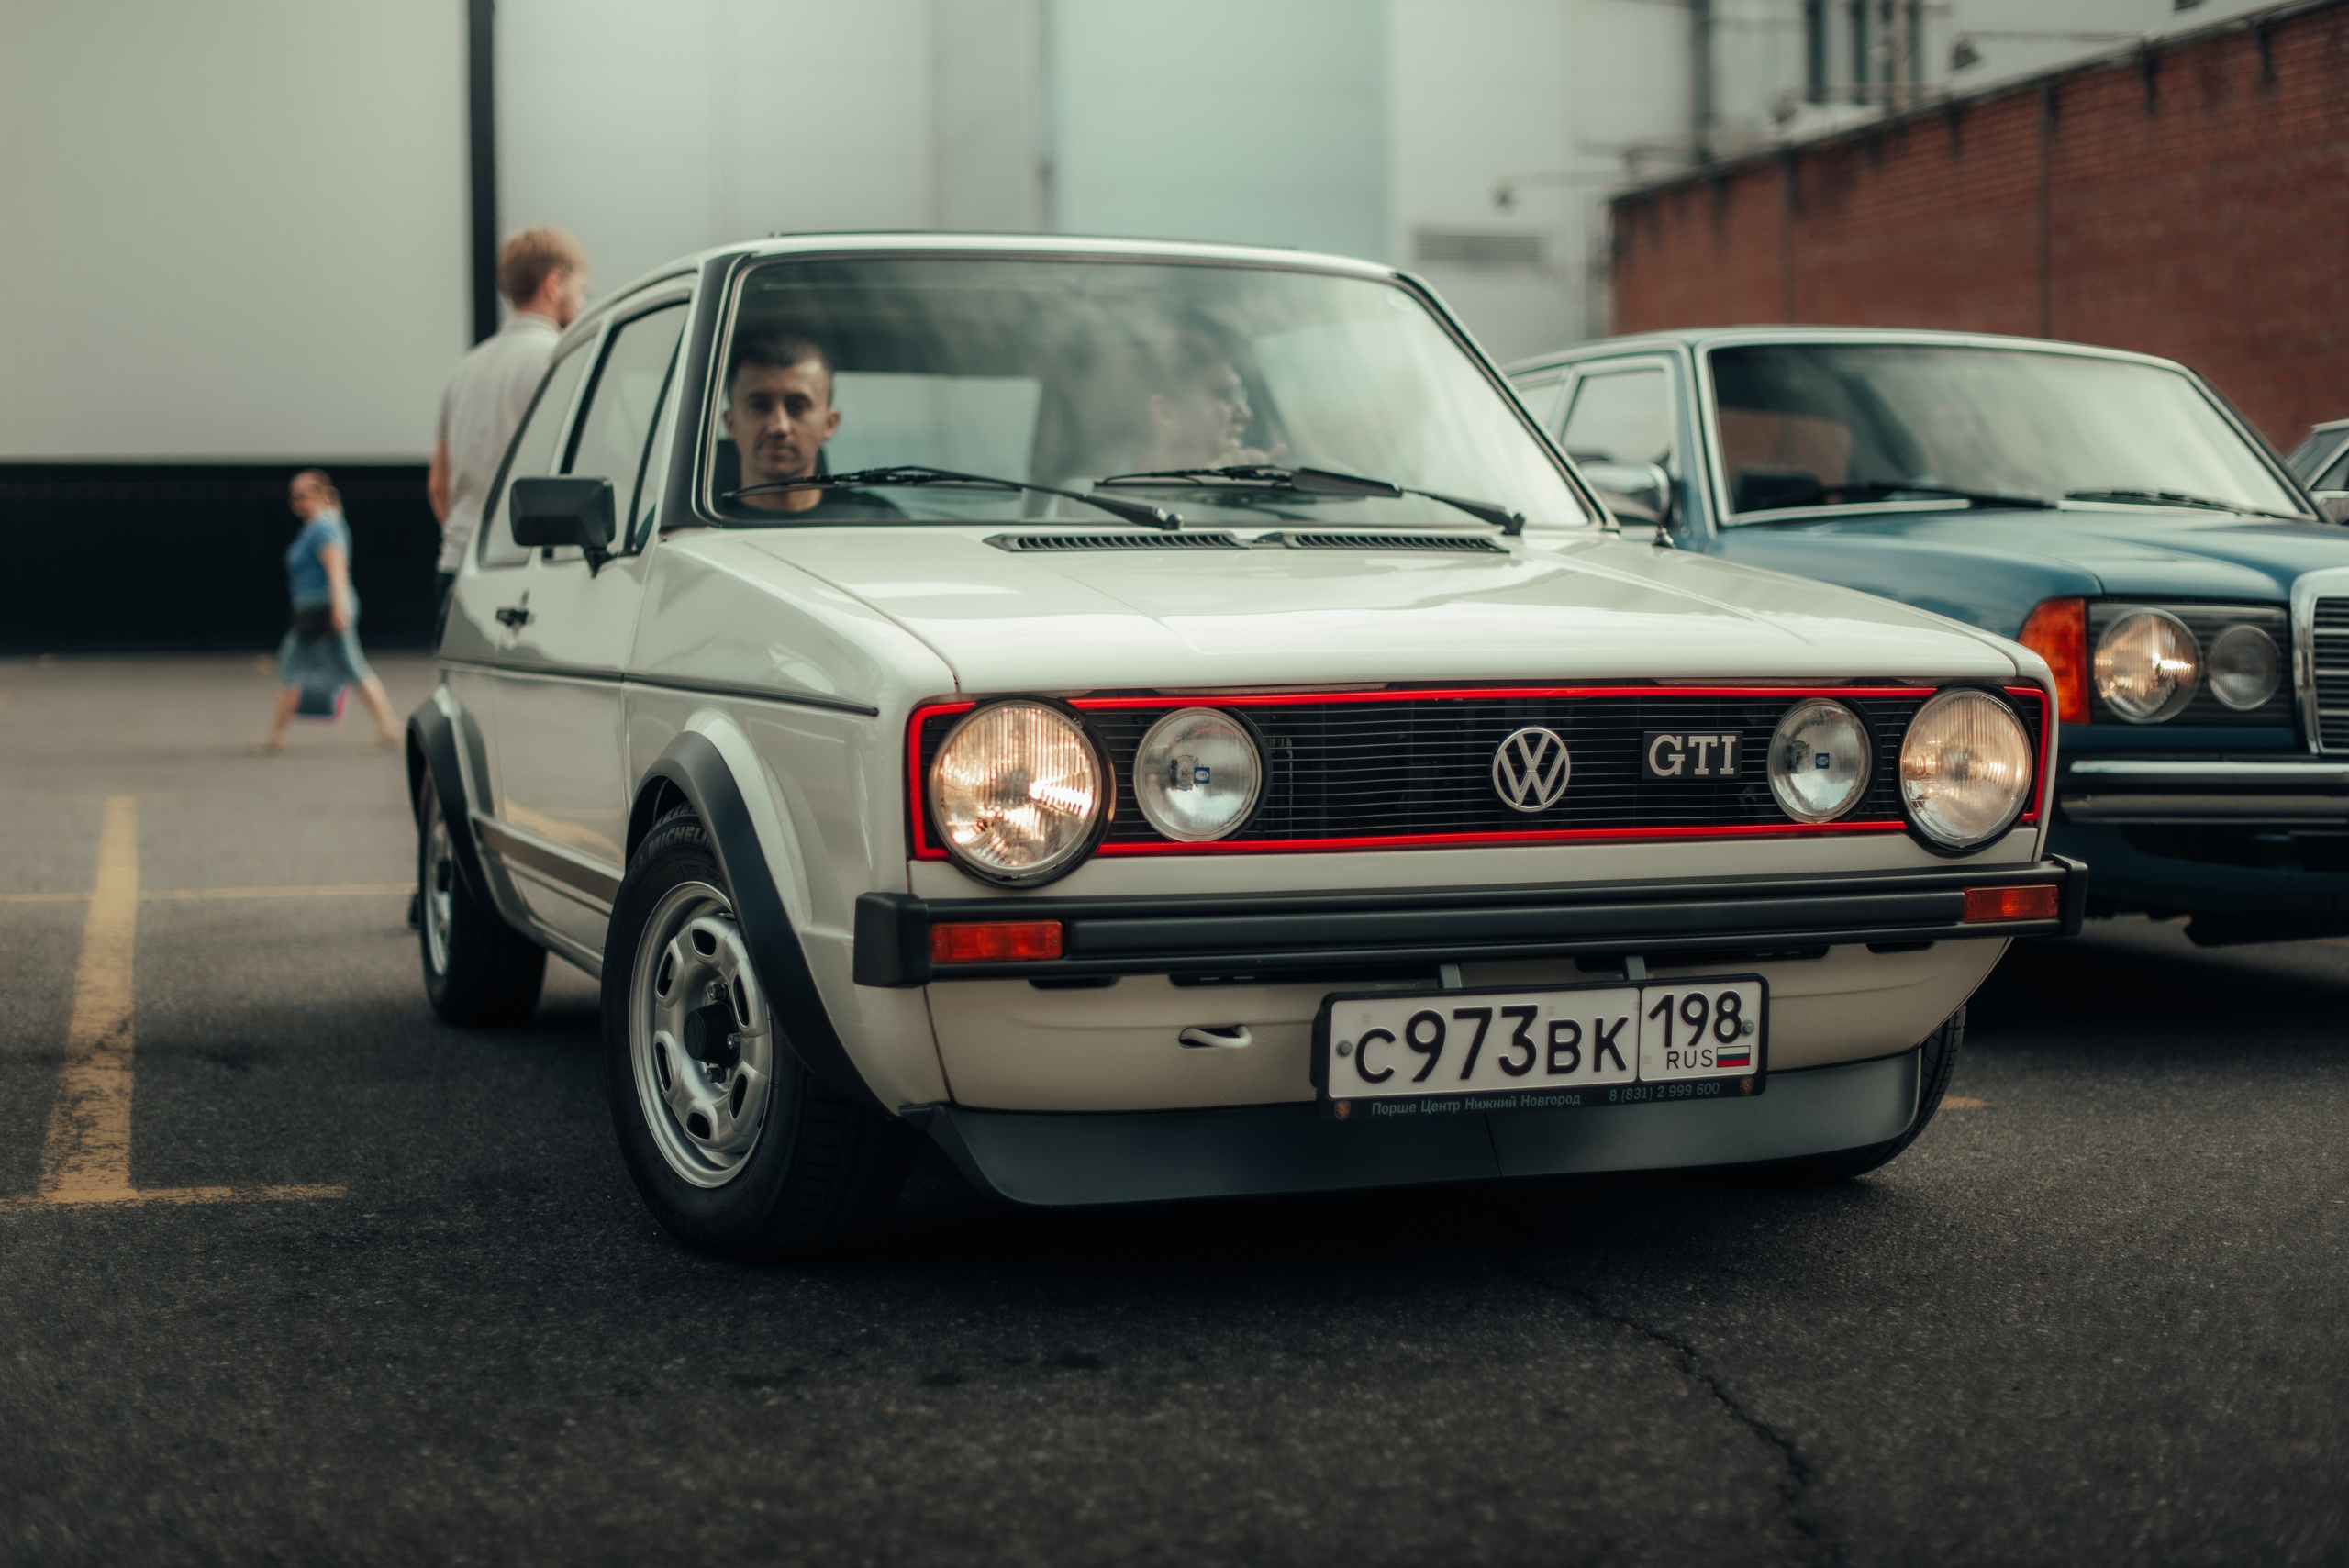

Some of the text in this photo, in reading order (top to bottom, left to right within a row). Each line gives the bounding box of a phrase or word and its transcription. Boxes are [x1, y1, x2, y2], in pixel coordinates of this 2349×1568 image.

[1493, 726, 1571, 813] VW
[1649, 735, 1736, 777] GTI
[1649, 989, 1742, 1048] 198
[1666, 1049, 1713, 1070] RUS
[1372, 1094, 1581, 1117] Порше Центр Нижний Новгород
[1609, 1082, 1720, 1103] 8 (831) 2 999 600
